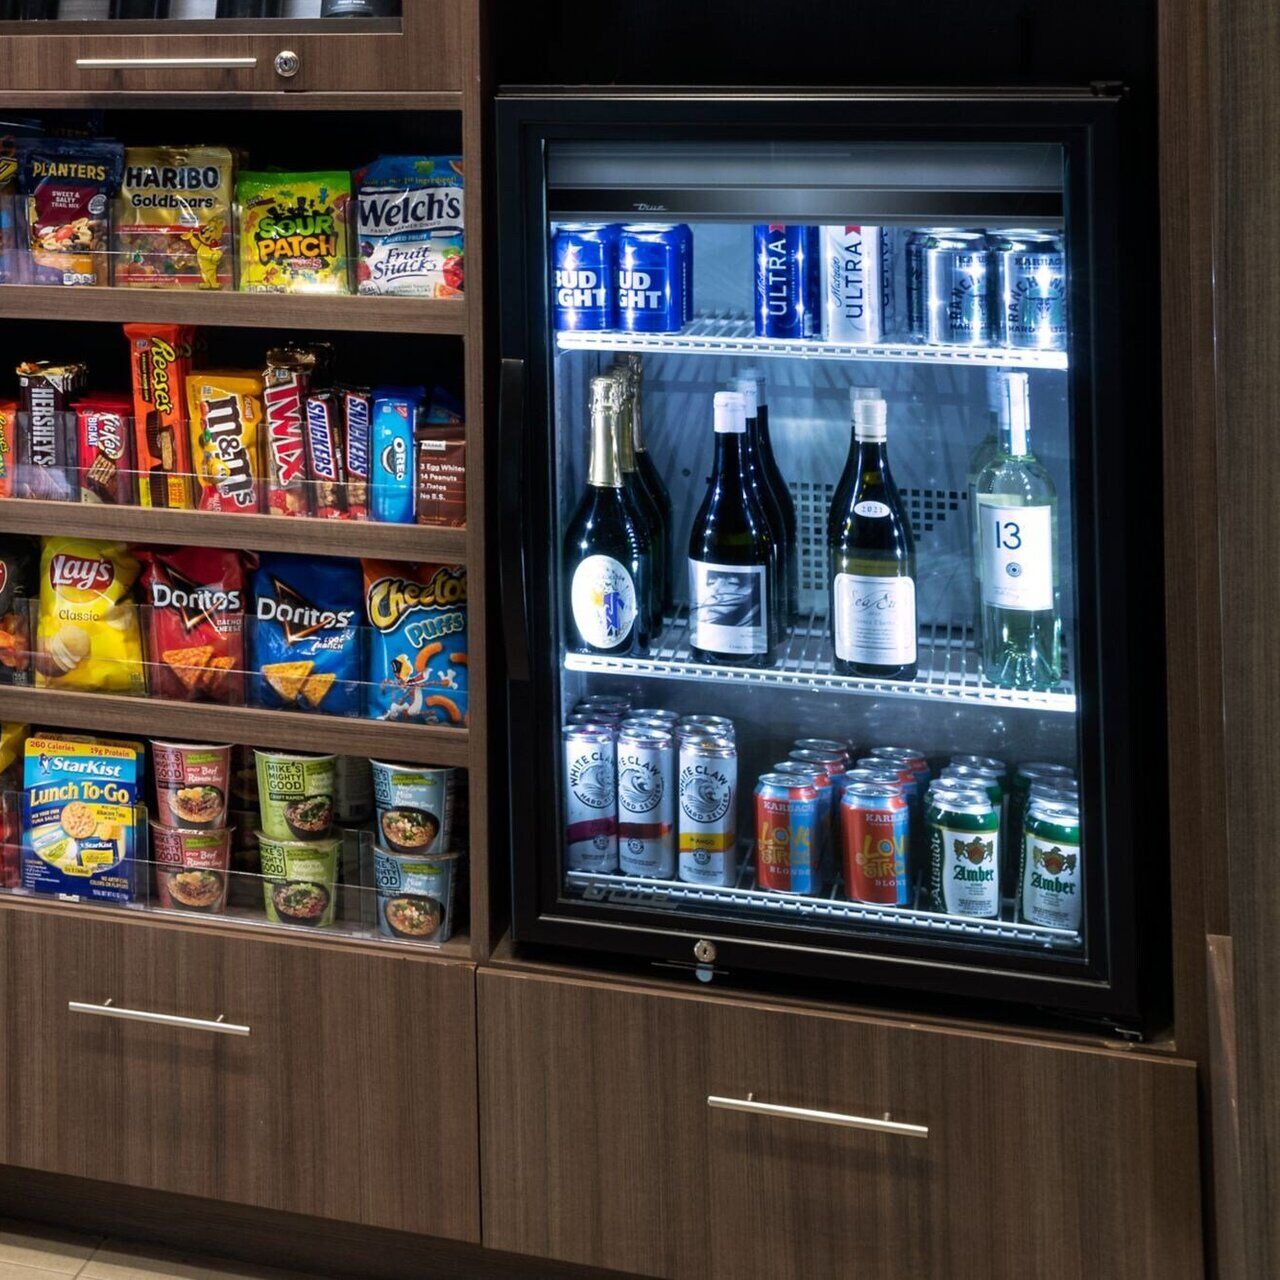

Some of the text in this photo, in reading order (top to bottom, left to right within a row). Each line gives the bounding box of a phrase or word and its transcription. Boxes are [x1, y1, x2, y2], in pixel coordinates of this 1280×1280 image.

[32, 162, 106, 181] PLANTERS
[125, 166, 220, 189] HARIBO
[51, 190, 74, 198] SWEET
[131, 194, 214, 209] Goldbears
[359, 192, 461, 228] Welch's
[259, 215, 333, 239] SOUR
[258, 236, 337, 264] PATCH
[385, 246, 432, 264] Fruit
[373, 260, 437, 280] Snacks
[619, 271, 652, 290] UD
[768, 238, 787, 317] ULTRA
[844, 241, 864, 320] ULTRA
[554, 288, 607, 308] GHT
[619, 289, 662, 309] GHT
[150, 337, 177, 416] Reese's
[31, 387, 56, 467] HERSHEY'S
[264, 373, 306, 486] TWIX
[347, 397, 368, 477] SNICKERS
[307, 399, 334, 479] SNICKERS
[393, 437, 407, 481] OREO
[426, 463, 440, 472] Egg
[441, 464, 465, 473] Whites
[427, 483, 447, 491] Dates
[429, 473, 457, 482] Peanuts
[995, 520, 1022, 550] 13
[52, 555, 112, 591] Lay's
[153, 583, 241, 610] Doritos
[58, 609, 100, 622] Classic
[256, 597, 351, 629] Doritos
[406, 612, 464, 648] PUFFS
[30, 740, 130, 758] 260 Calories 19g Protein
[51, 757, 122, 777] StarKist
[267, 763, 301, 774] MIKE'S
[570, 755, 590, 788] WHITE
[627, 755, 661, 776] CLAW
[695, 765, 728, 786] CLAW
[268, 773, 302, 782] MIGHTY
[269, 781, 302, 791] GOOD
[30, 781, 79, 807] Lunch
[85, 841, 113, 849] StarKist
[864, 834, 905, 858] LOV
[953, 864, 994, 882] Amber
[1030, 871, 1076, 895] Amber
